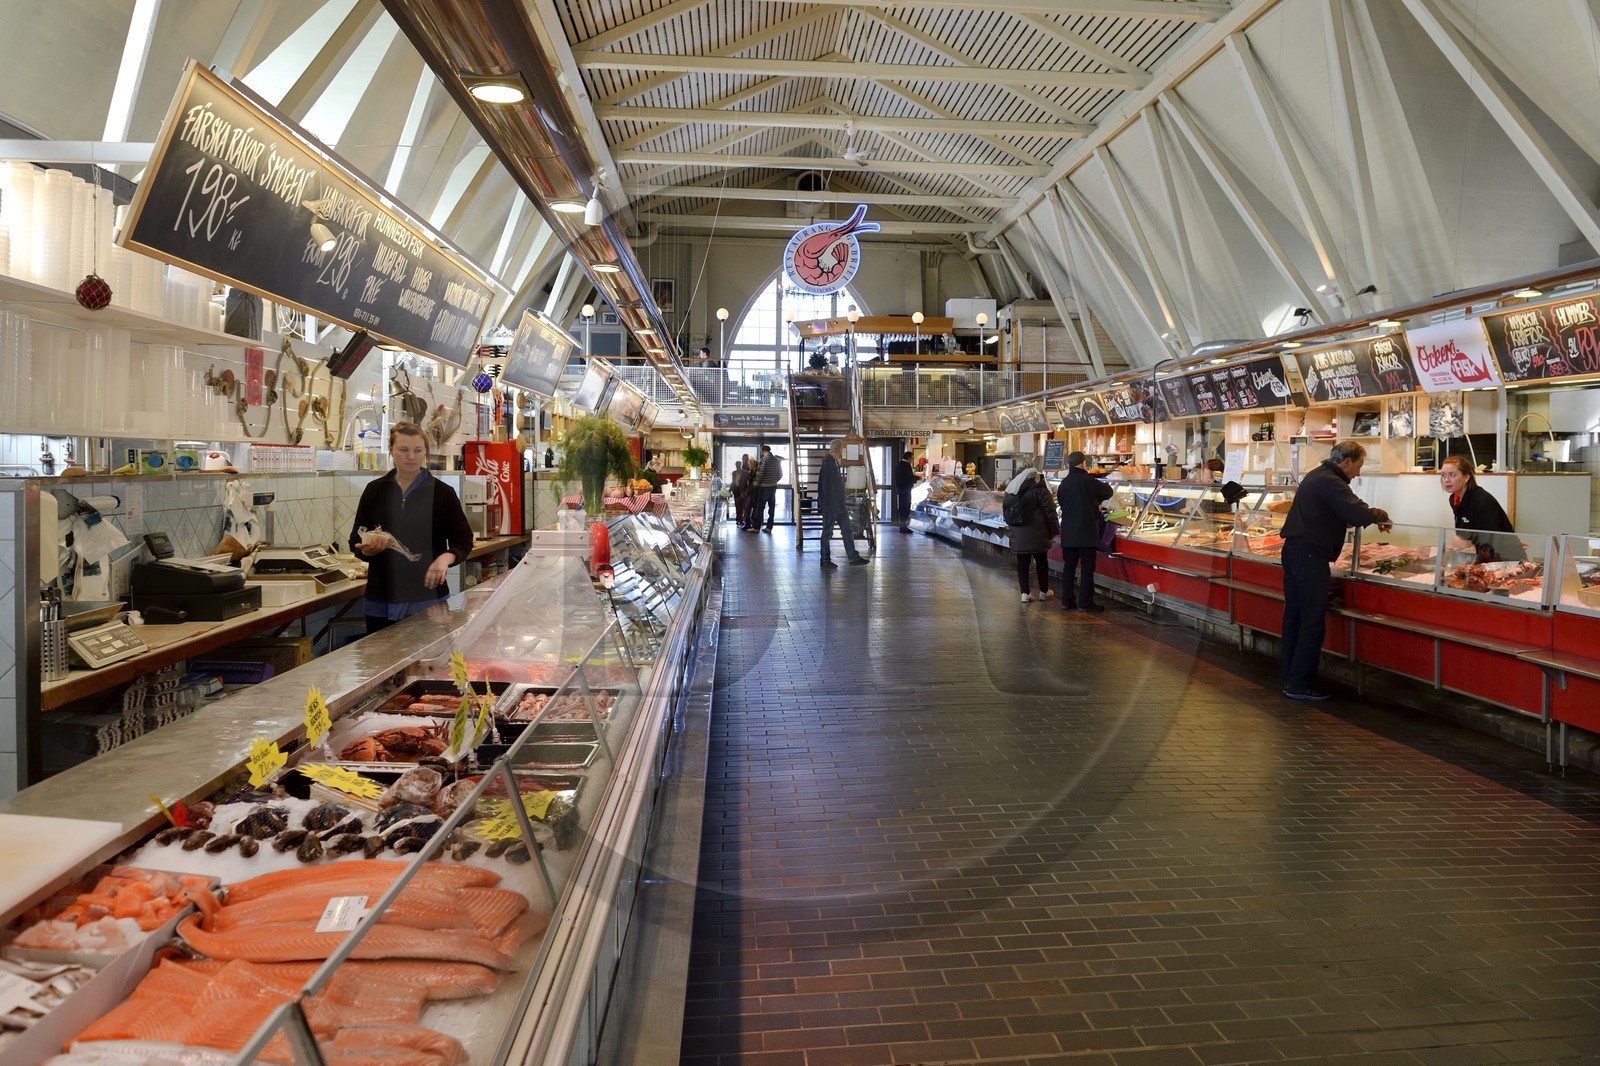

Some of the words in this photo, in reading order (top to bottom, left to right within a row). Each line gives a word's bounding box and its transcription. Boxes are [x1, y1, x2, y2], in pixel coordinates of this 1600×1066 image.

[373, 211, 411, 249] HUNNEBO
[408, 236, 426, 259] FISK
[786, 225, 832, 277] RESTAURANG
[841, 234, 859, 281] GABRIEL
[1556, 302, 1596, 327] HUMMER
[1454, 358, 1479, 377] FISK
[500, 461, 510, 482] Coke
